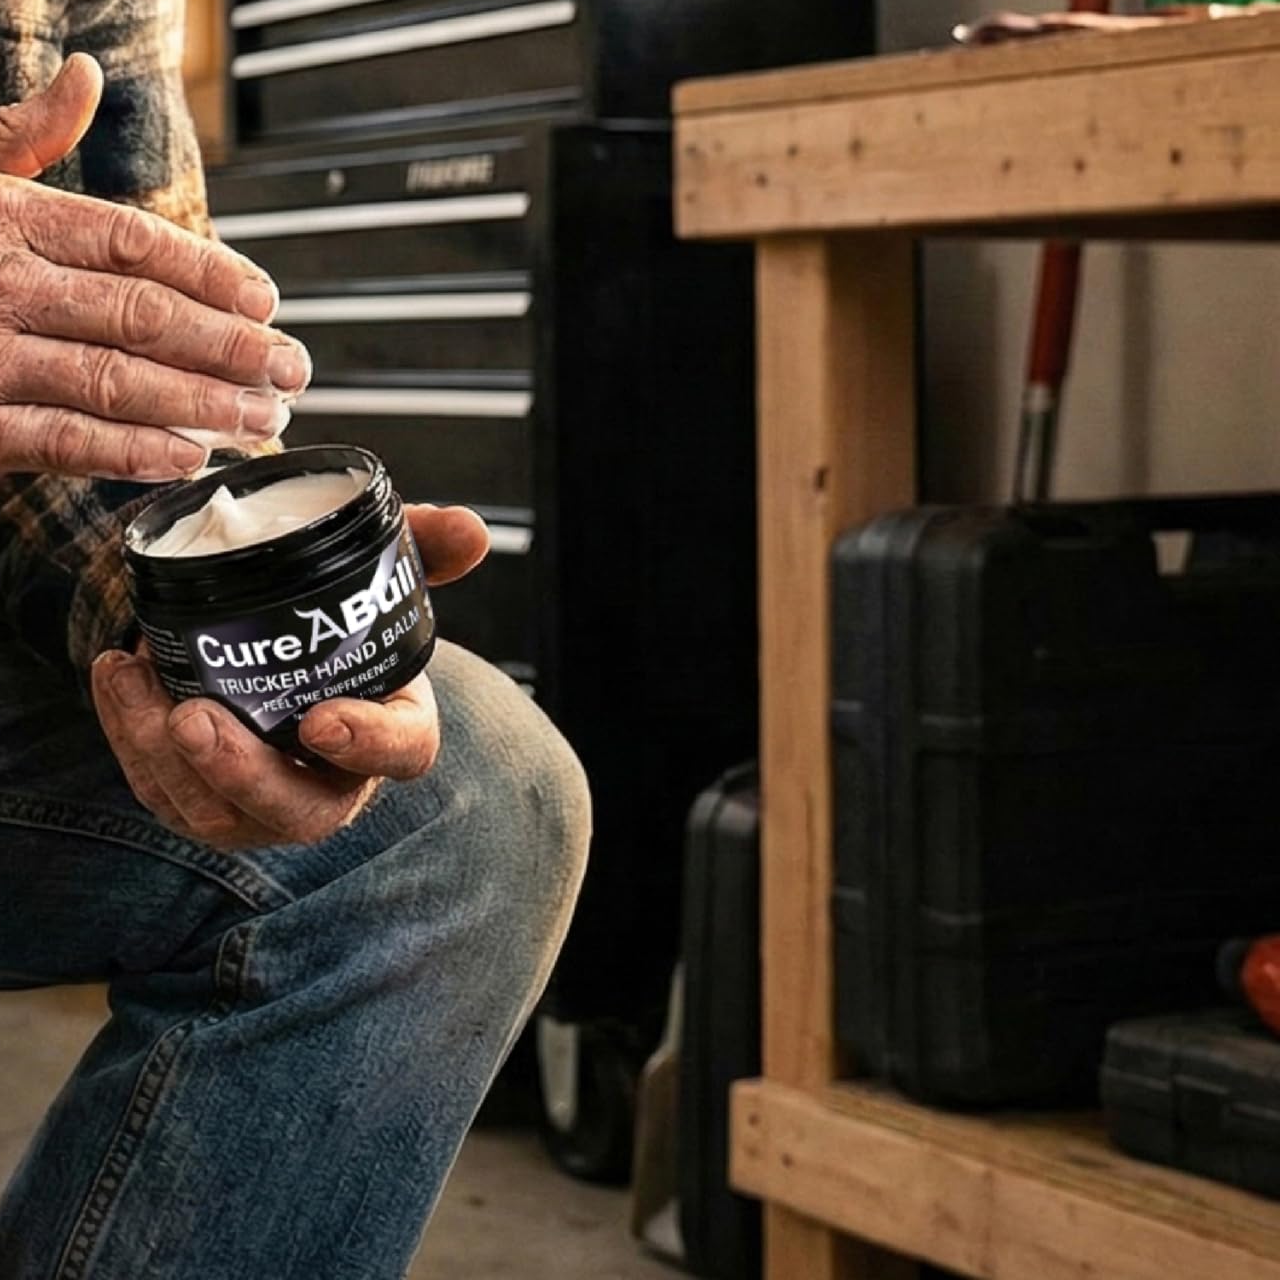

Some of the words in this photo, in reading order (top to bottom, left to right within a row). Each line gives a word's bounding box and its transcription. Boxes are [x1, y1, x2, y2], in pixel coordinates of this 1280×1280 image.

[217, 669, 310, 696] TRUCKER
[314, 641, 377, 680] HAND
[381, 607, 420, 648] BALM
[263, 697, 293, 713] FEEL
[294, 689, 321, 706] THE
[324, 652, 399, 698] DIFFERENCE!
